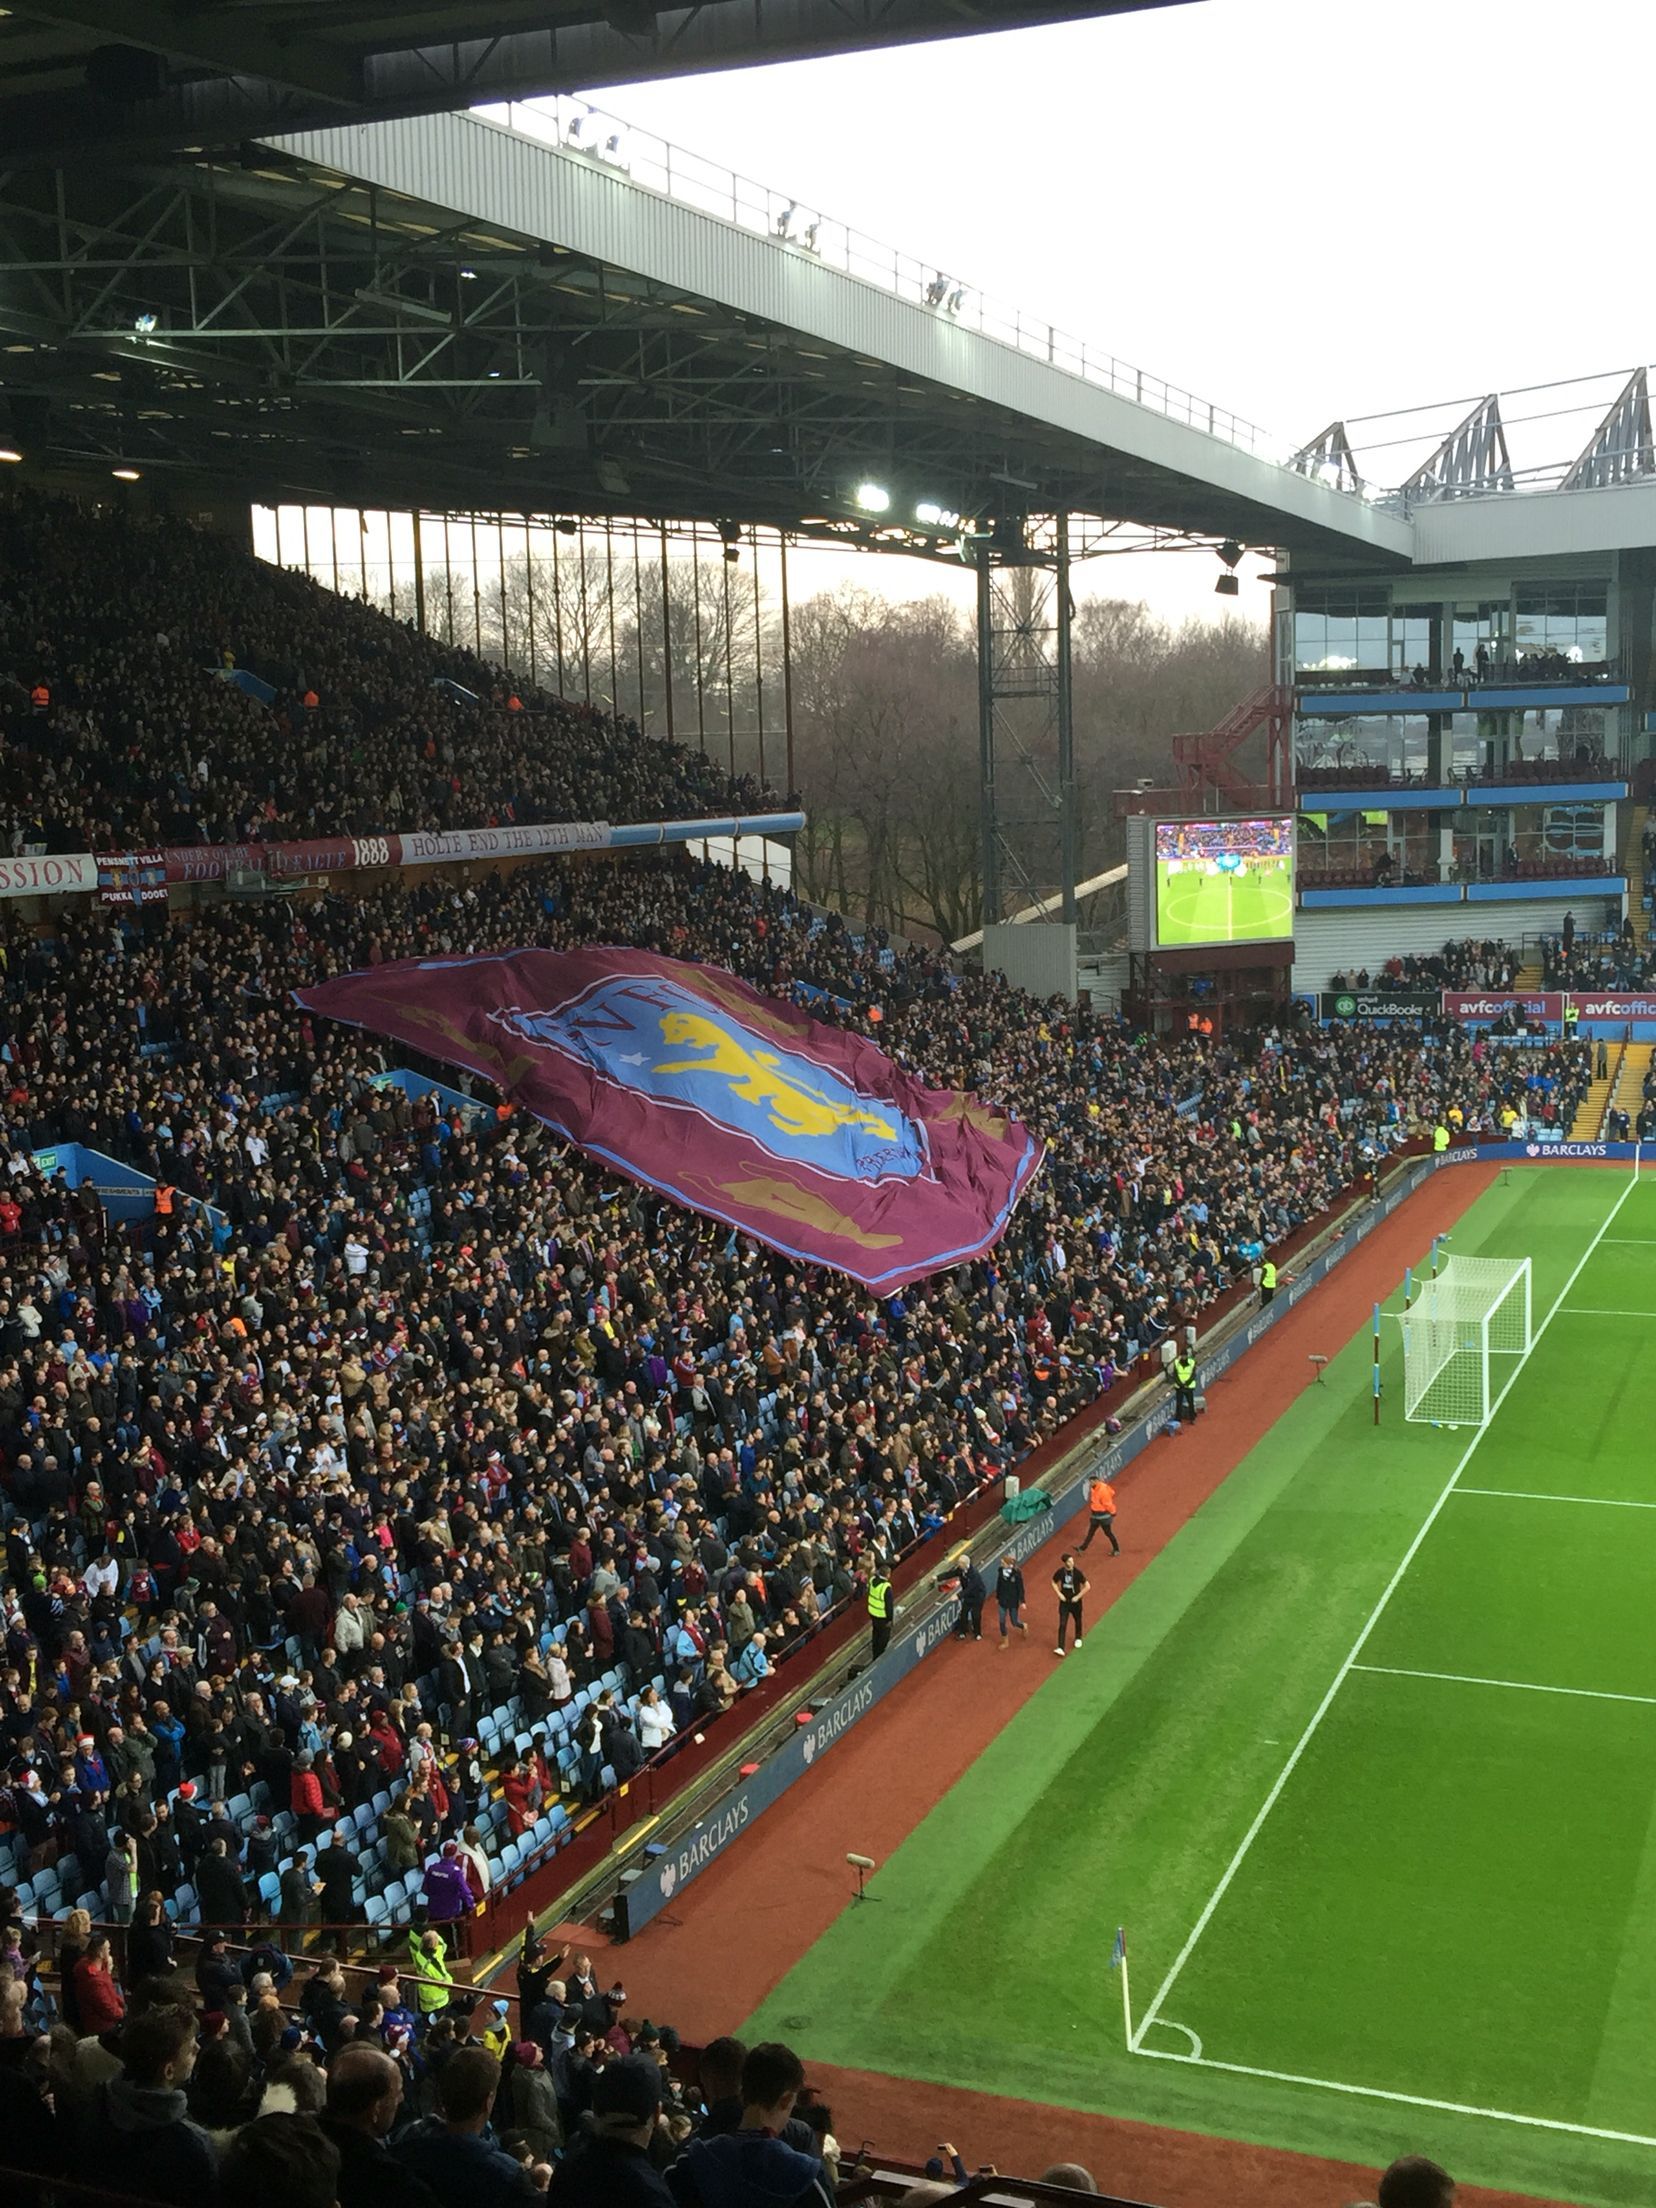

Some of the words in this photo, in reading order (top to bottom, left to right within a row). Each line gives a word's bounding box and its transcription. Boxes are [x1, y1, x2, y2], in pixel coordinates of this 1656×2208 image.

[352, 836, 389, 866] 1888
[411, 834, 462, 857] HOLTE
[469, 831, 499, 851] END
[501, 830, 534, 849] THE
[537, 827, 569, 846] 12TH
[576, 824, 603, 844] MAN
[0, 858, 84, 889] SSION
[140, 853, 164, 864] VILLA
[101, 891, 134, 902] PUKKA
[1356, 1002, 1423, 1016] QuickBooks
[41, 1153, 56, 1167] EXIT
[1542, 1145, 1607, 1156] BARCLAYS
[1017, 1511, 1055, 1562] BARCLAYS
[927, 1599, 962, 1646] BARCLA
[818, 1680, 873, 1749] BARCLAYS
[679, 1795, 749, 1882] BARCLAYS
